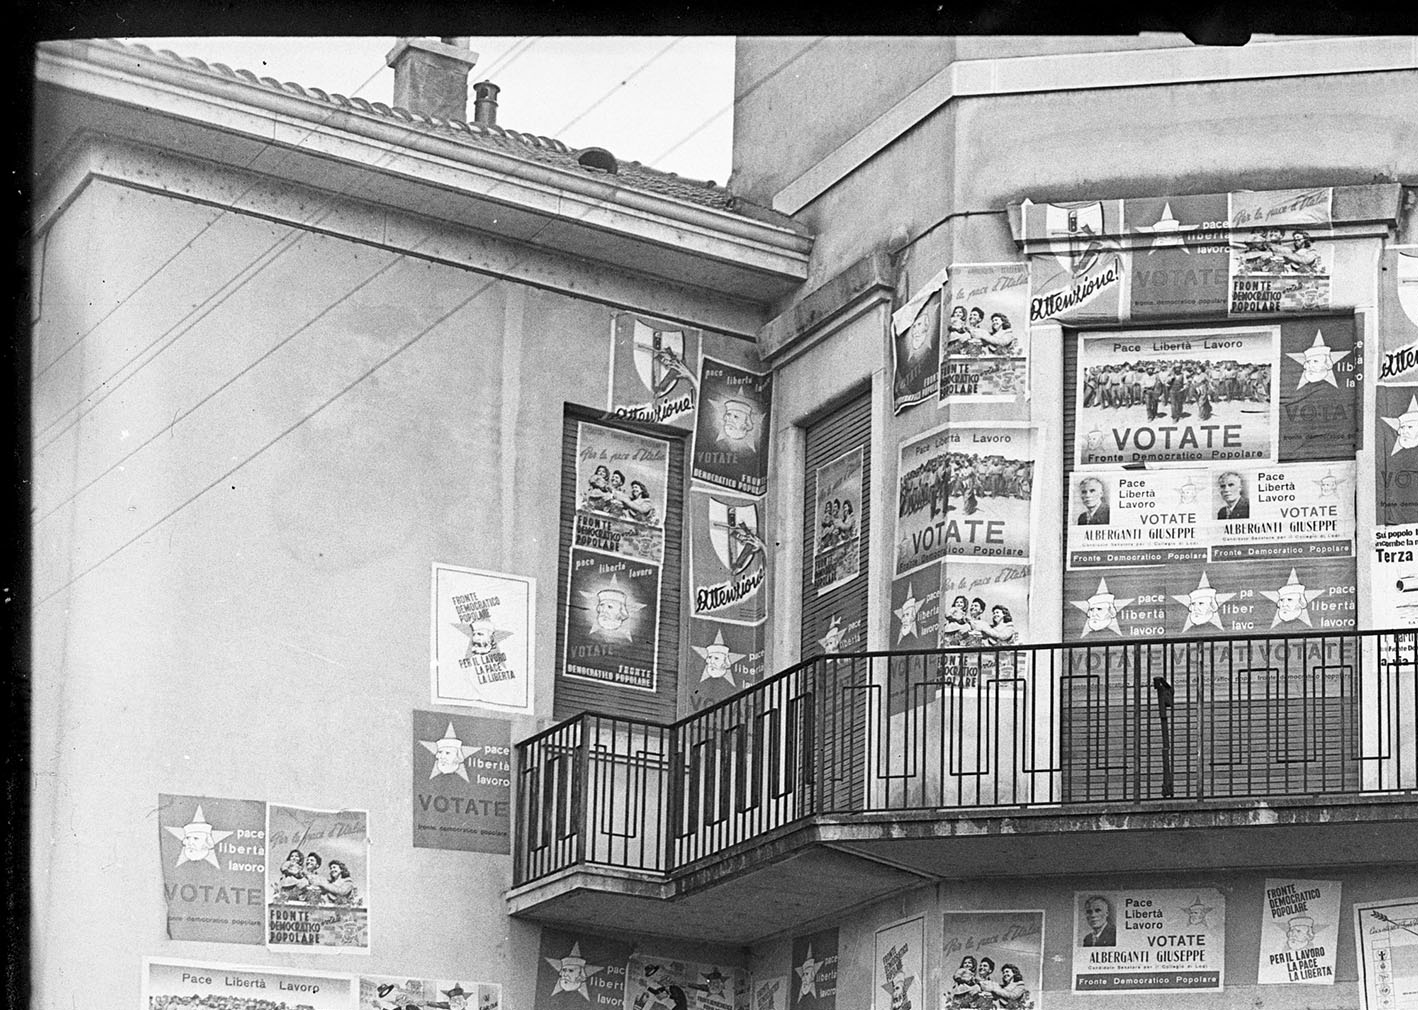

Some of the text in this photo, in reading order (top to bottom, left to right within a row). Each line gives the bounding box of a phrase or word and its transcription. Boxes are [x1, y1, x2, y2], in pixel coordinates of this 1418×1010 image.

[1233, 281, 1272, 291] FRONTE
[1232, 291, 1282, 301] DEMOCRATICO
[1232, 301, 1280, 312] POPOLARE
[1114, 339, 1242, 352] Pace Libertà Lavoro
[1112, 426, 1242, 451] VOTATE
[1088, 449, 1263, 462] Fronte Democratico Popolare
[1259, 472, 1285, 481] Pace
[1259, 482, 1295, 491] Libertà
[1259, 493, 1295, 502] Lavoro
[1281, 506, 1337, 518] VOTATE
[1224, 520, 1337, 535] ALBERGANTI GIUSEPPE
[1388, 529, 1412, 538] popolo
[1215, 545, 1349, 556] Fronte Democratico Popolare
[1376, 549, 1413, 562] Terza
[1329, 585, 1355, 595] pace
[452, 592, 477, 606] FRONTE
[456, 596, 500, 614] DEMOCRATICO
[1311, 600, 1355, 611] libertà
[1321, 617, 1355, 627] lavoro
[1267, 884, 1296, 899] FRONTE
[1125, 898, 1152, 908] Pace
[1269, 889, 1321, 909] DEMOCRATICO
[1125, 908, 1163, 919] Libertà
[1271, 902, 1308, 918] POPOLARE
[1125, 919, 1163, 930] Lavoro
[1148, 934, 1205, 947] VOTATE
[1089, 948, 1205, 963] ALBERGANTI GIUSEPPE
[182, 973, 320, 993] Pace Libertà Lavoro
[1079, 973, 1216, 986] Fronte Democratico Popolare
